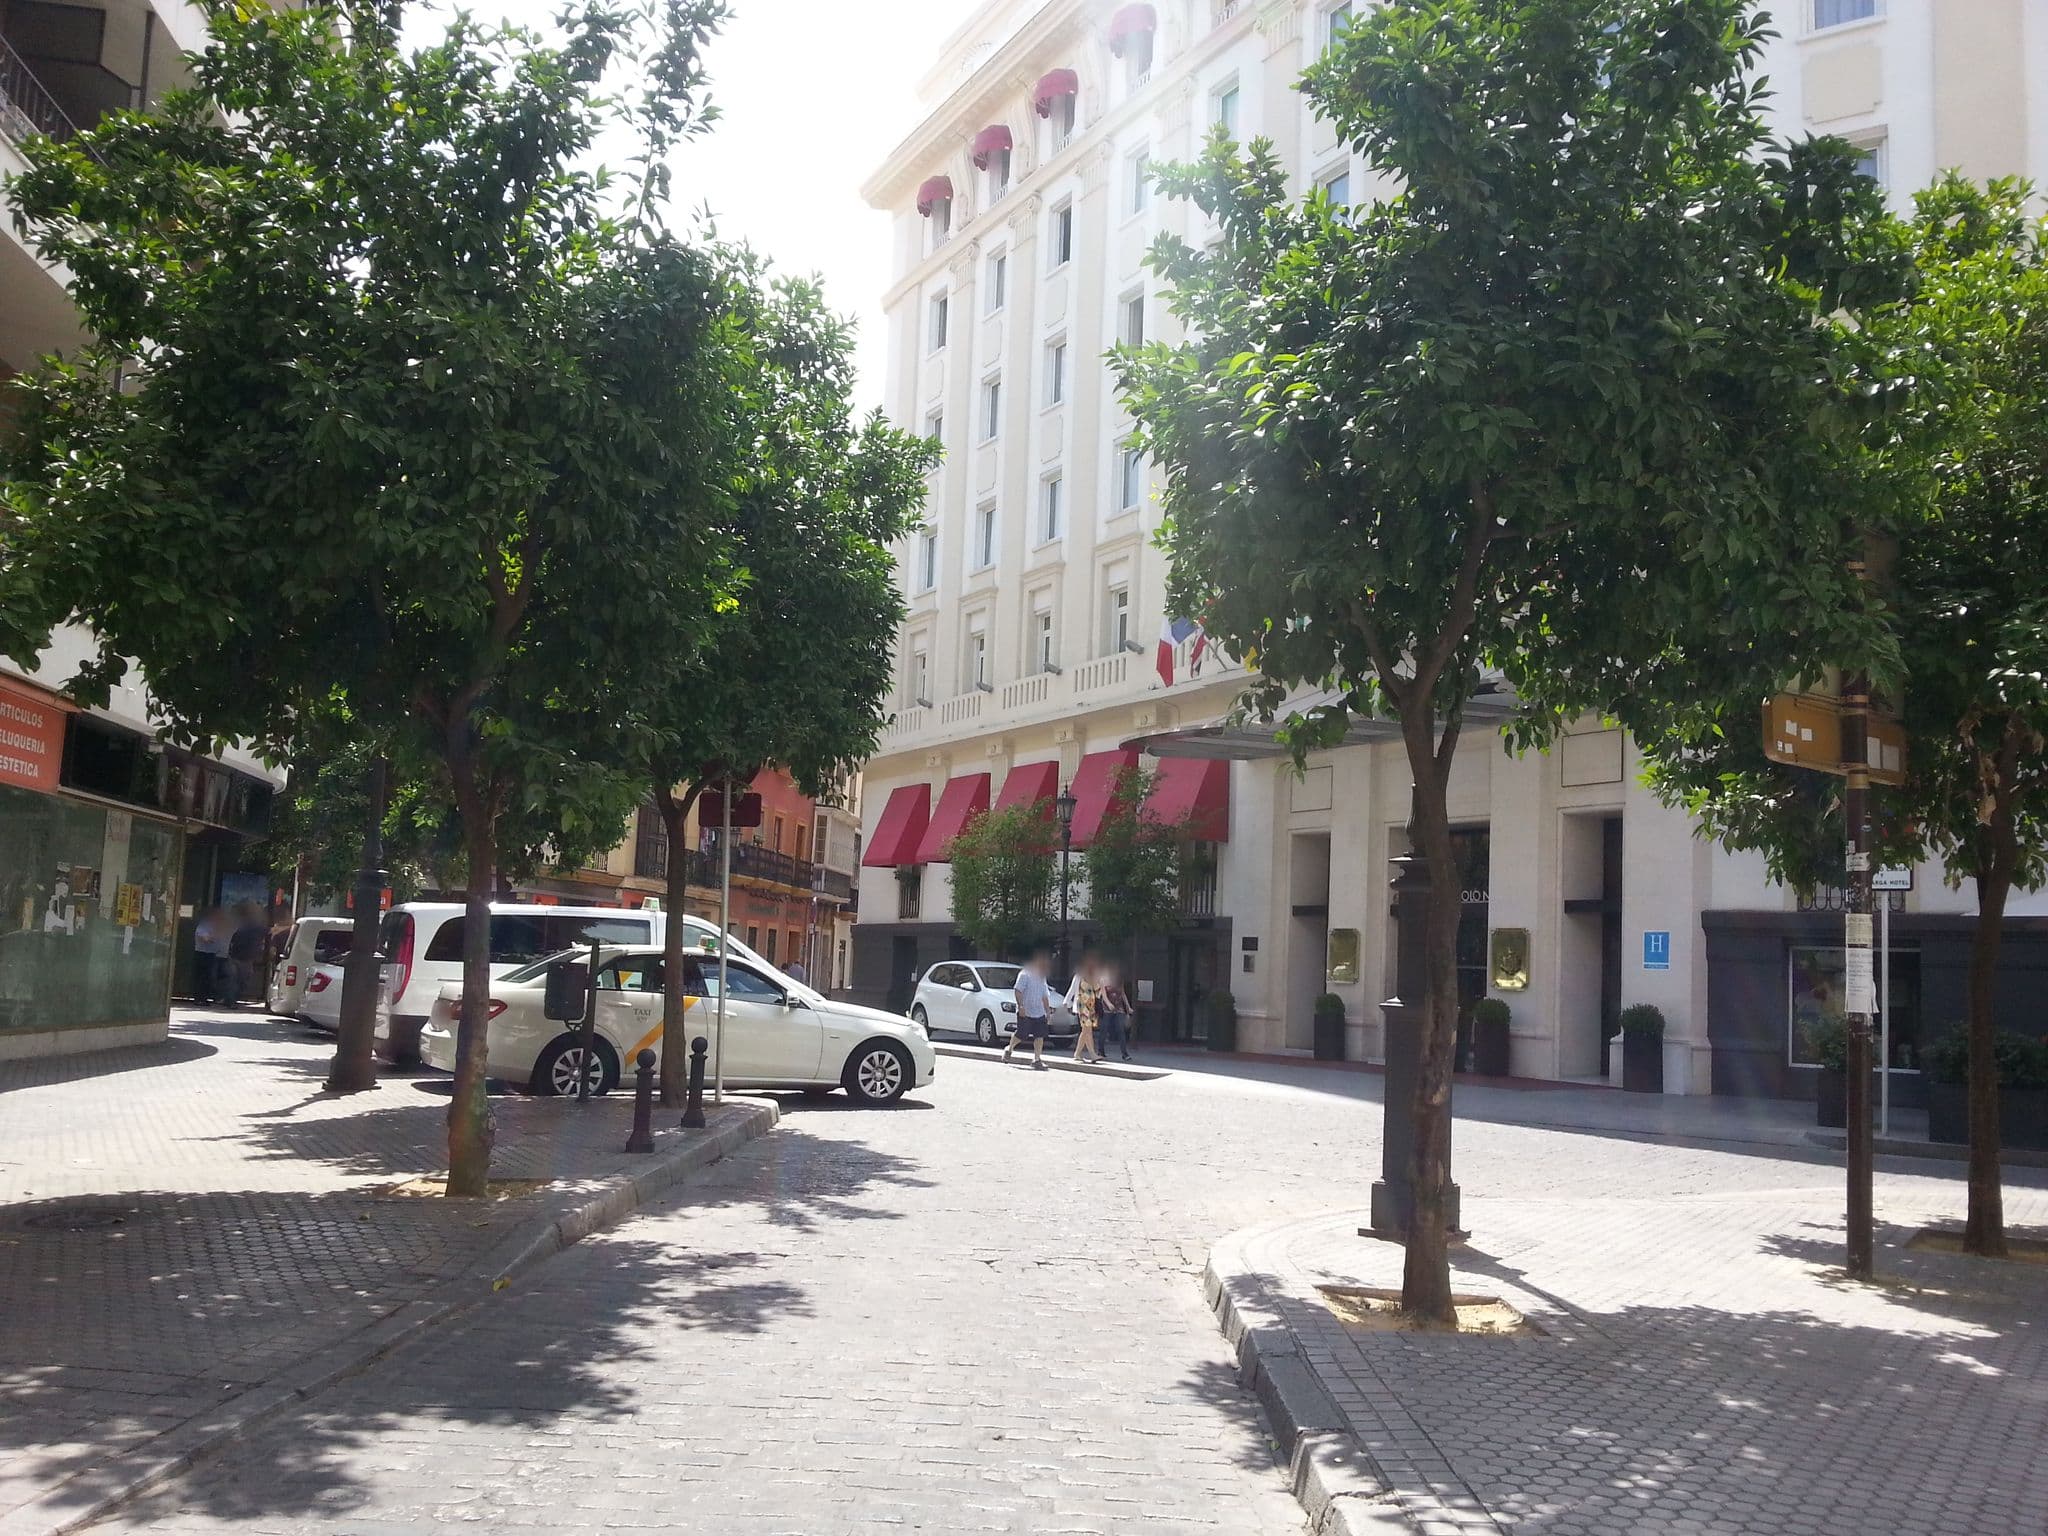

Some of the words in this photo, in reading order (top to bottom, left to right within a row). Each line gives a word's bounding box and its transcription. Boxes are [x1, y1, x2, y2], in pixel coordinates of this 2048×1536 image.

[0, 702, 43, 728] RTICULOS
[0, 729, 45, 754] ELUQUERIA
[1650, 934, 1663, 953] H
[633, 1008, 651, 1017] TAXI
